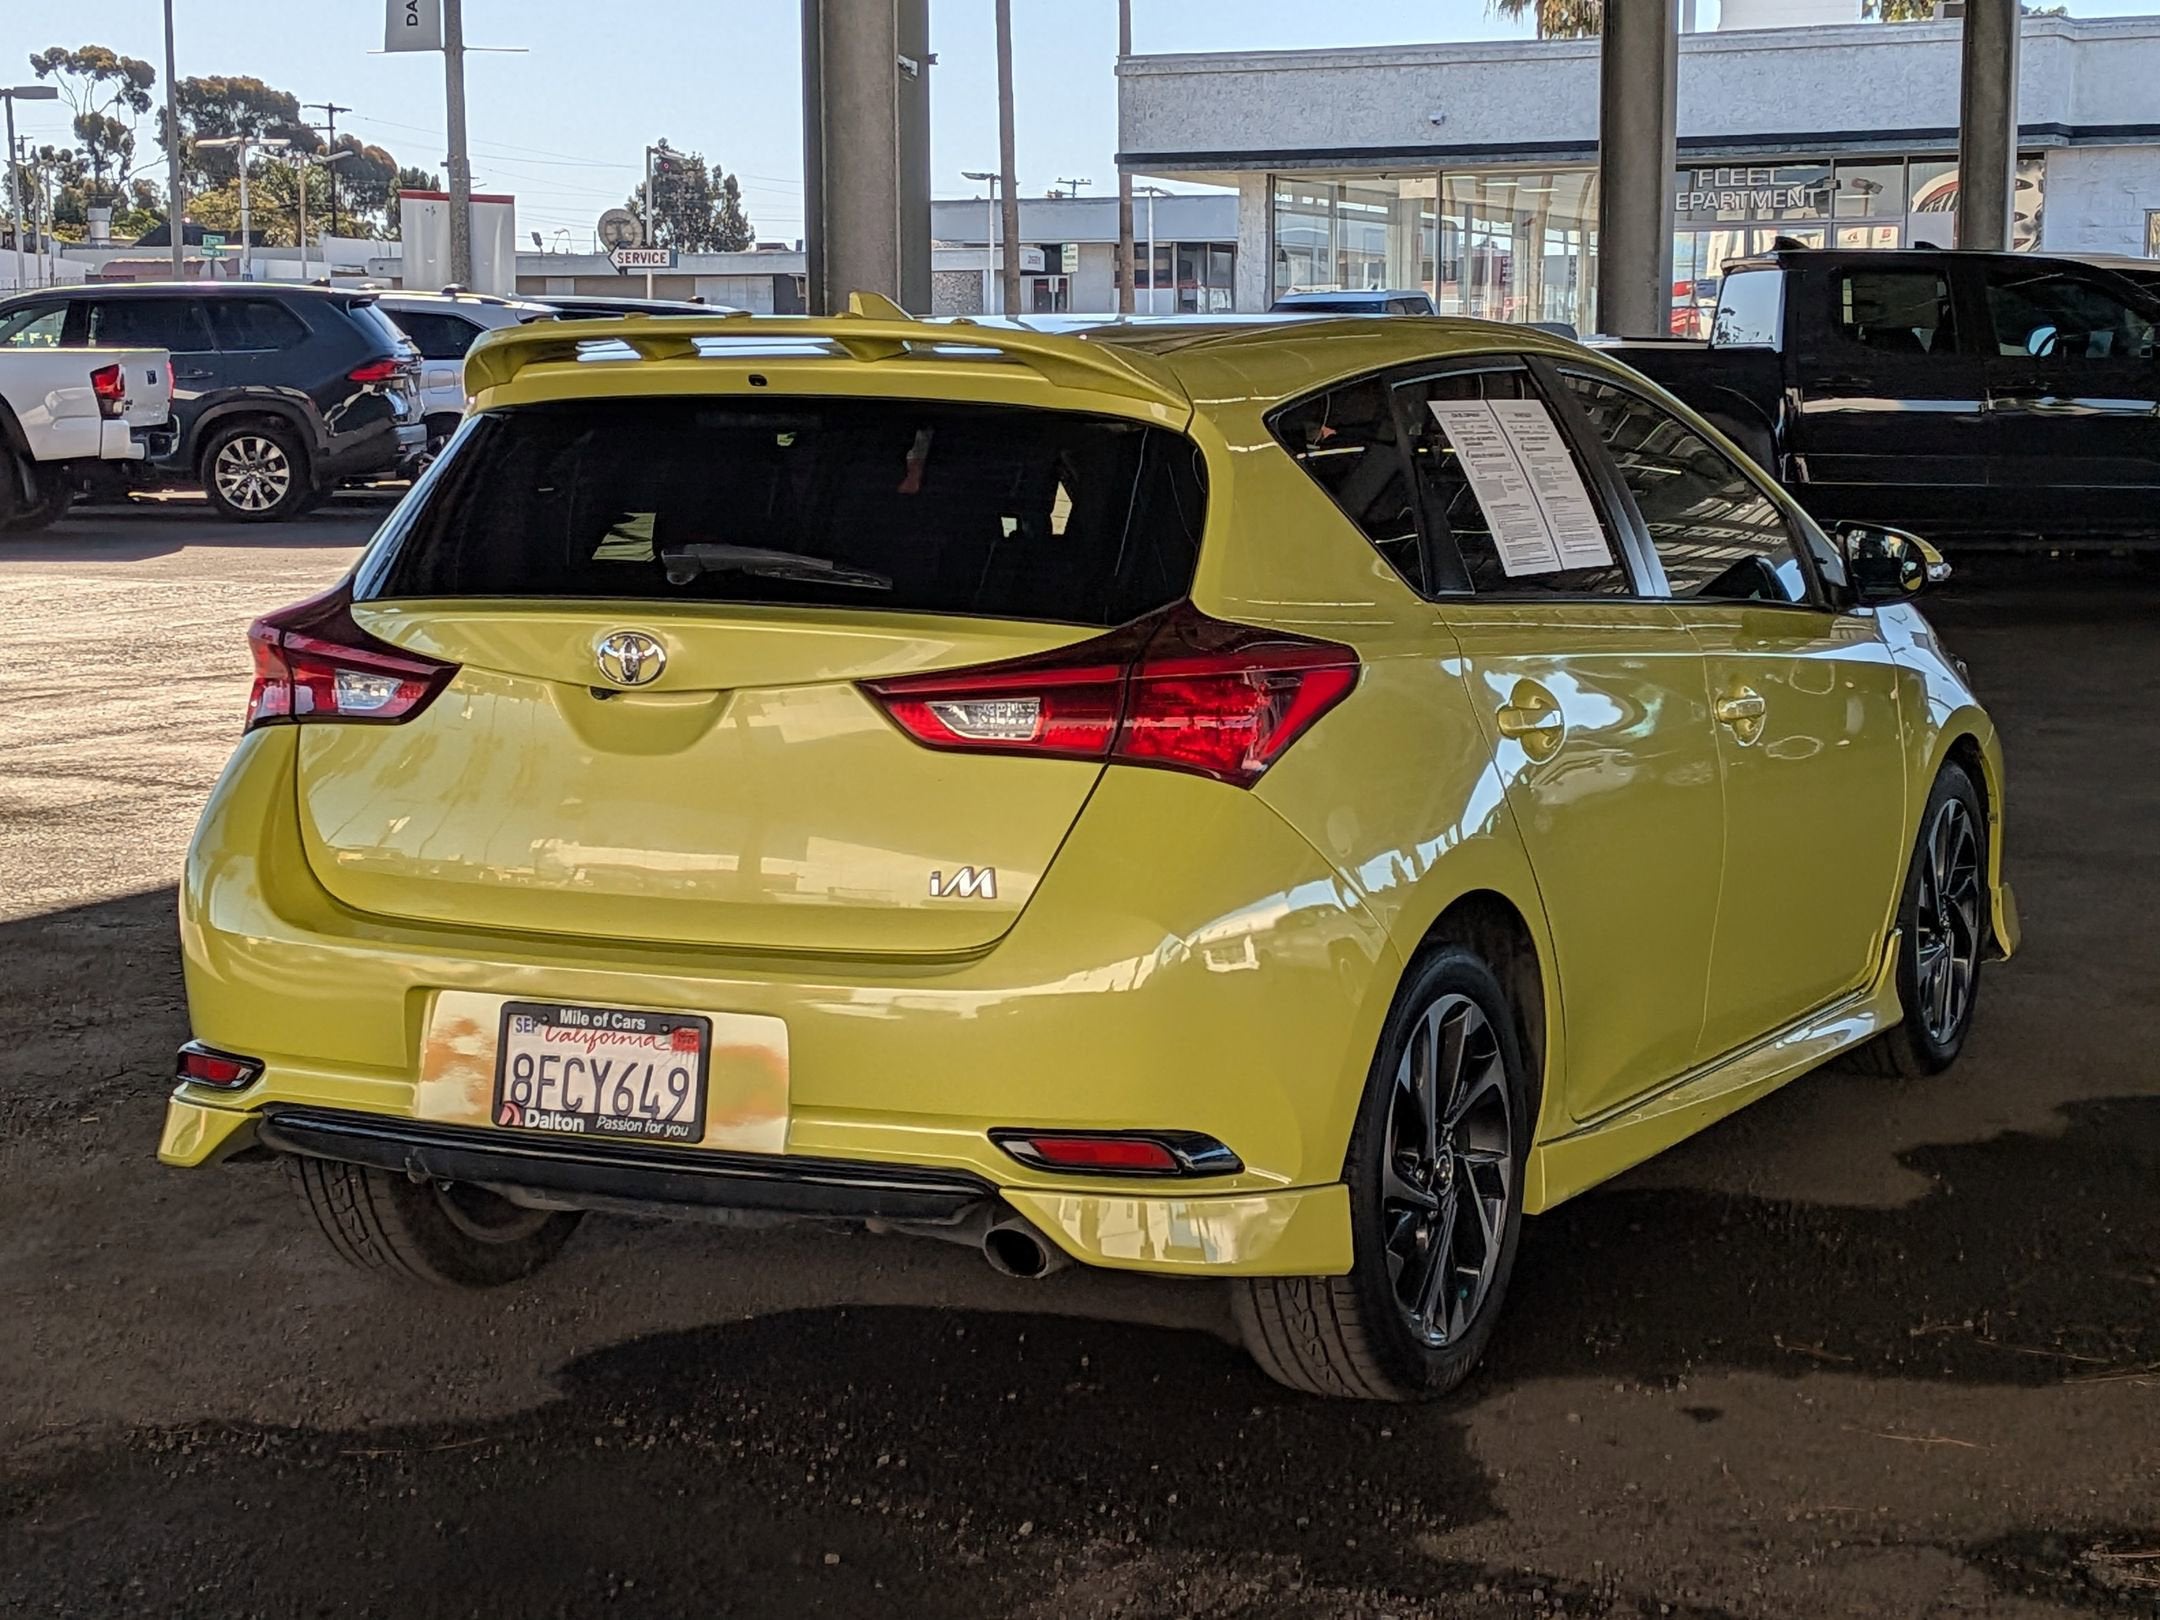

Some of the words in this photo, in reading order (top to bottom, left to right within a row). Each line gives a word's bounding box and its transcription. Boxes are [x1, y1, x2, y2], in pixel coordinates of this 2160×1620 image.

[1696, 168, 1780, 187] FLEET
[1675, 189, 1817, 211] EPARTMENT
[617, 252, 667, 264] SERVICE
[559, 1008, 590, 1026] Mile
[593, 1012, 611, 1027] of
[611, 1013, 646, 1031] Cars
[545, 1025, 670, 1055] California
[510, 1052, 690, 1121] 8FCY649
[524, 1108, 586, 1133] Dalton
[595, 1115, 643, 1134] Passion
[644, 1120, 663, 1134] for
[664, 1122, 689, 1138] you
